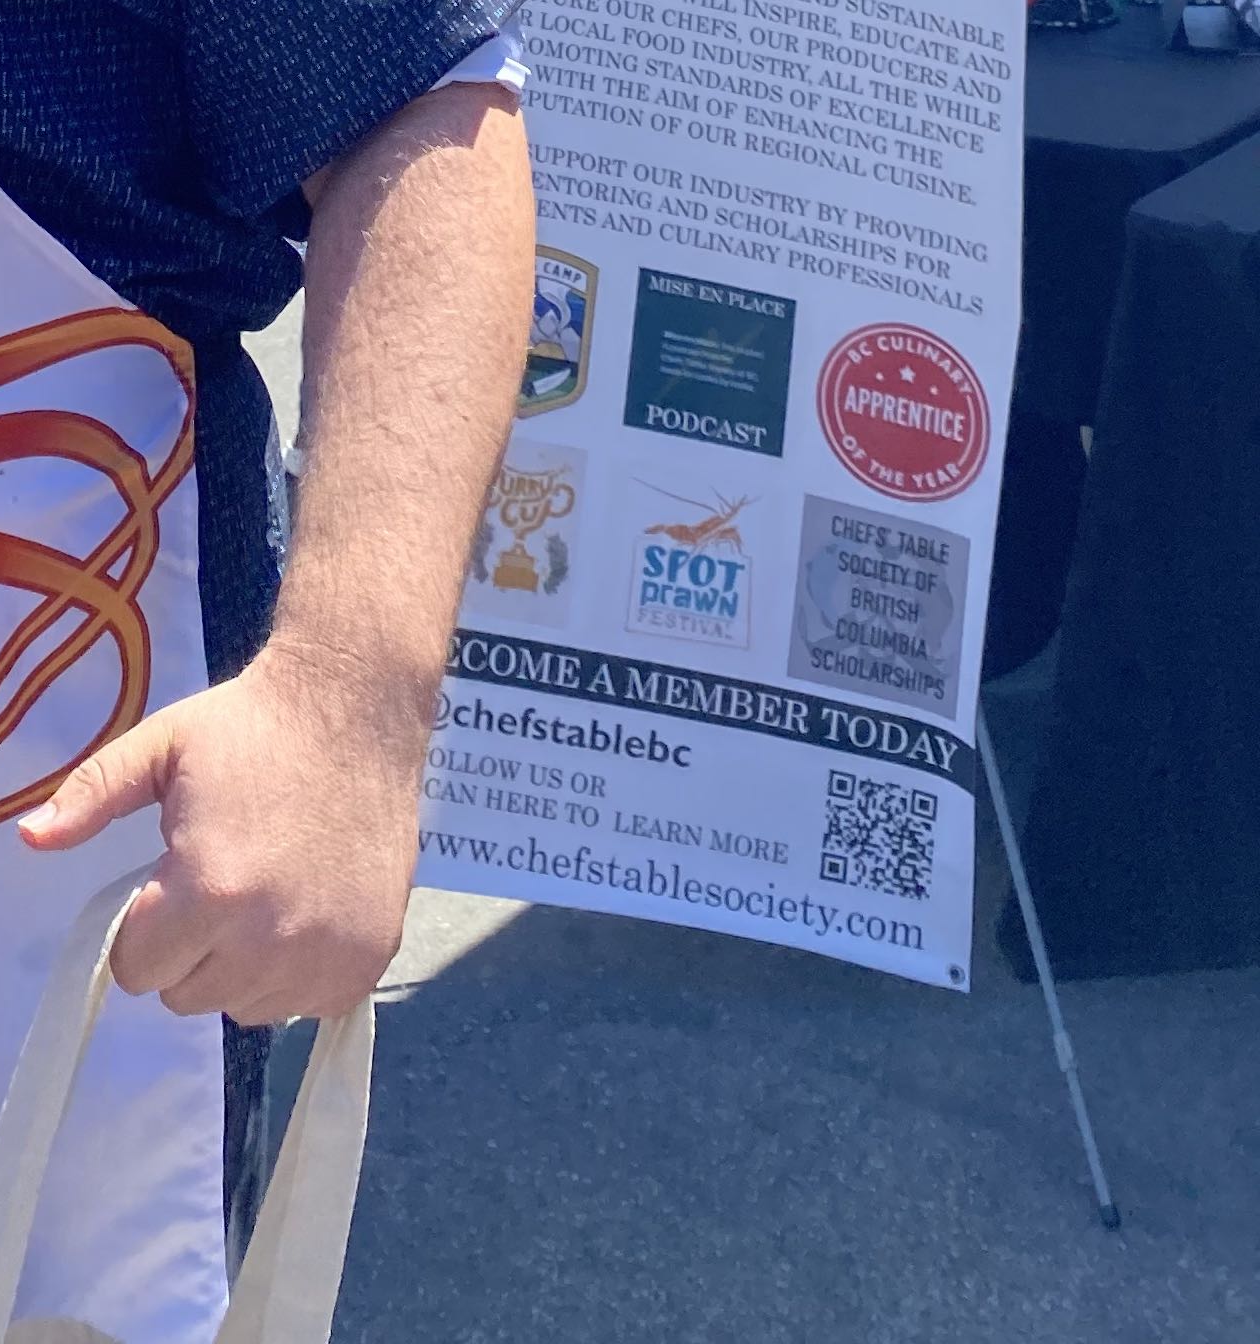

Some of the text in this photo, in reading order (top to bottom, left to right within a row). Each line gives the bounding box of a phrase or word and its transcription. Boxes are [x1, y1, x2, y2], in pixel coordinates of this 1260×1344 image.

[540, 12, 616, 42] LOCAL
[623, 27, 685, 55] FOOD
[693, 41, 813, 86] INDUSTRY,
[818, 70, 864, 95] ALL
[869, 80, 917, 108] THE
[925, 94, 1001, 132] WHILE
[750, 27, 799, 54] OUR
[806, 38, 948, 89] PRODUCERS
[953, 76, 1001, 104] AND
[850, 21, 959, 65] EDUCATE
[963, 53, 1011, 80] AND
[524, 37, 985, 154] OMOTING STANDARDS OF EXCELLENCE
[535, 64, 943, 169] WITH THE AIM OF ENHANCING THE
[521, 88, 644, 127] PUTATION
[650, 113, 681, 135] OF
[687, 121, 737, 148] OUR
[743, 132, 867, 177] REGIONAL
[533, 171, 951, 280] ENTORING AND SCHOLARSHIPS FOR
[633, 164, 683, 190] OUR
[690, 174, 811, 217] INDUSTRY
[818, 202, 848, 226] BY
[855, 211, 988, 262] PROVIDING
[536, 198, 984, 316] ENTS AND CULINARY PROFESSIONALS
[543, 262, 582, 283] CAMP
[649, 275, 786, 318] MISE EN PLACE
[877, 336, 973, 394] CULINARY
[646, 404, 767, 447] PODCAST
[845, 385, 965, 442] APPRENTICE
[842, 435, 960, 488] OF THE YEAR
[643, 544, 745, 593] SPOT
[838, 551, 939, 594] SOCIETY OF
[898, 531, 950, 565] TABLE
[637, 609, 733, 639] FESTIVAL
[851, 588, 920, 623] BRITISH
[836, 618, 928, 660] COLUMBIA
[811, 647, 945, 700] SCHOLARSHIPS
[443, 636, 958, 772] ECOME A MEMBER TODAY
[428, 748, 606, 798] OLLOW US OR
[424, 778, 789, 864] CAN HERE TO LEARN MORE
